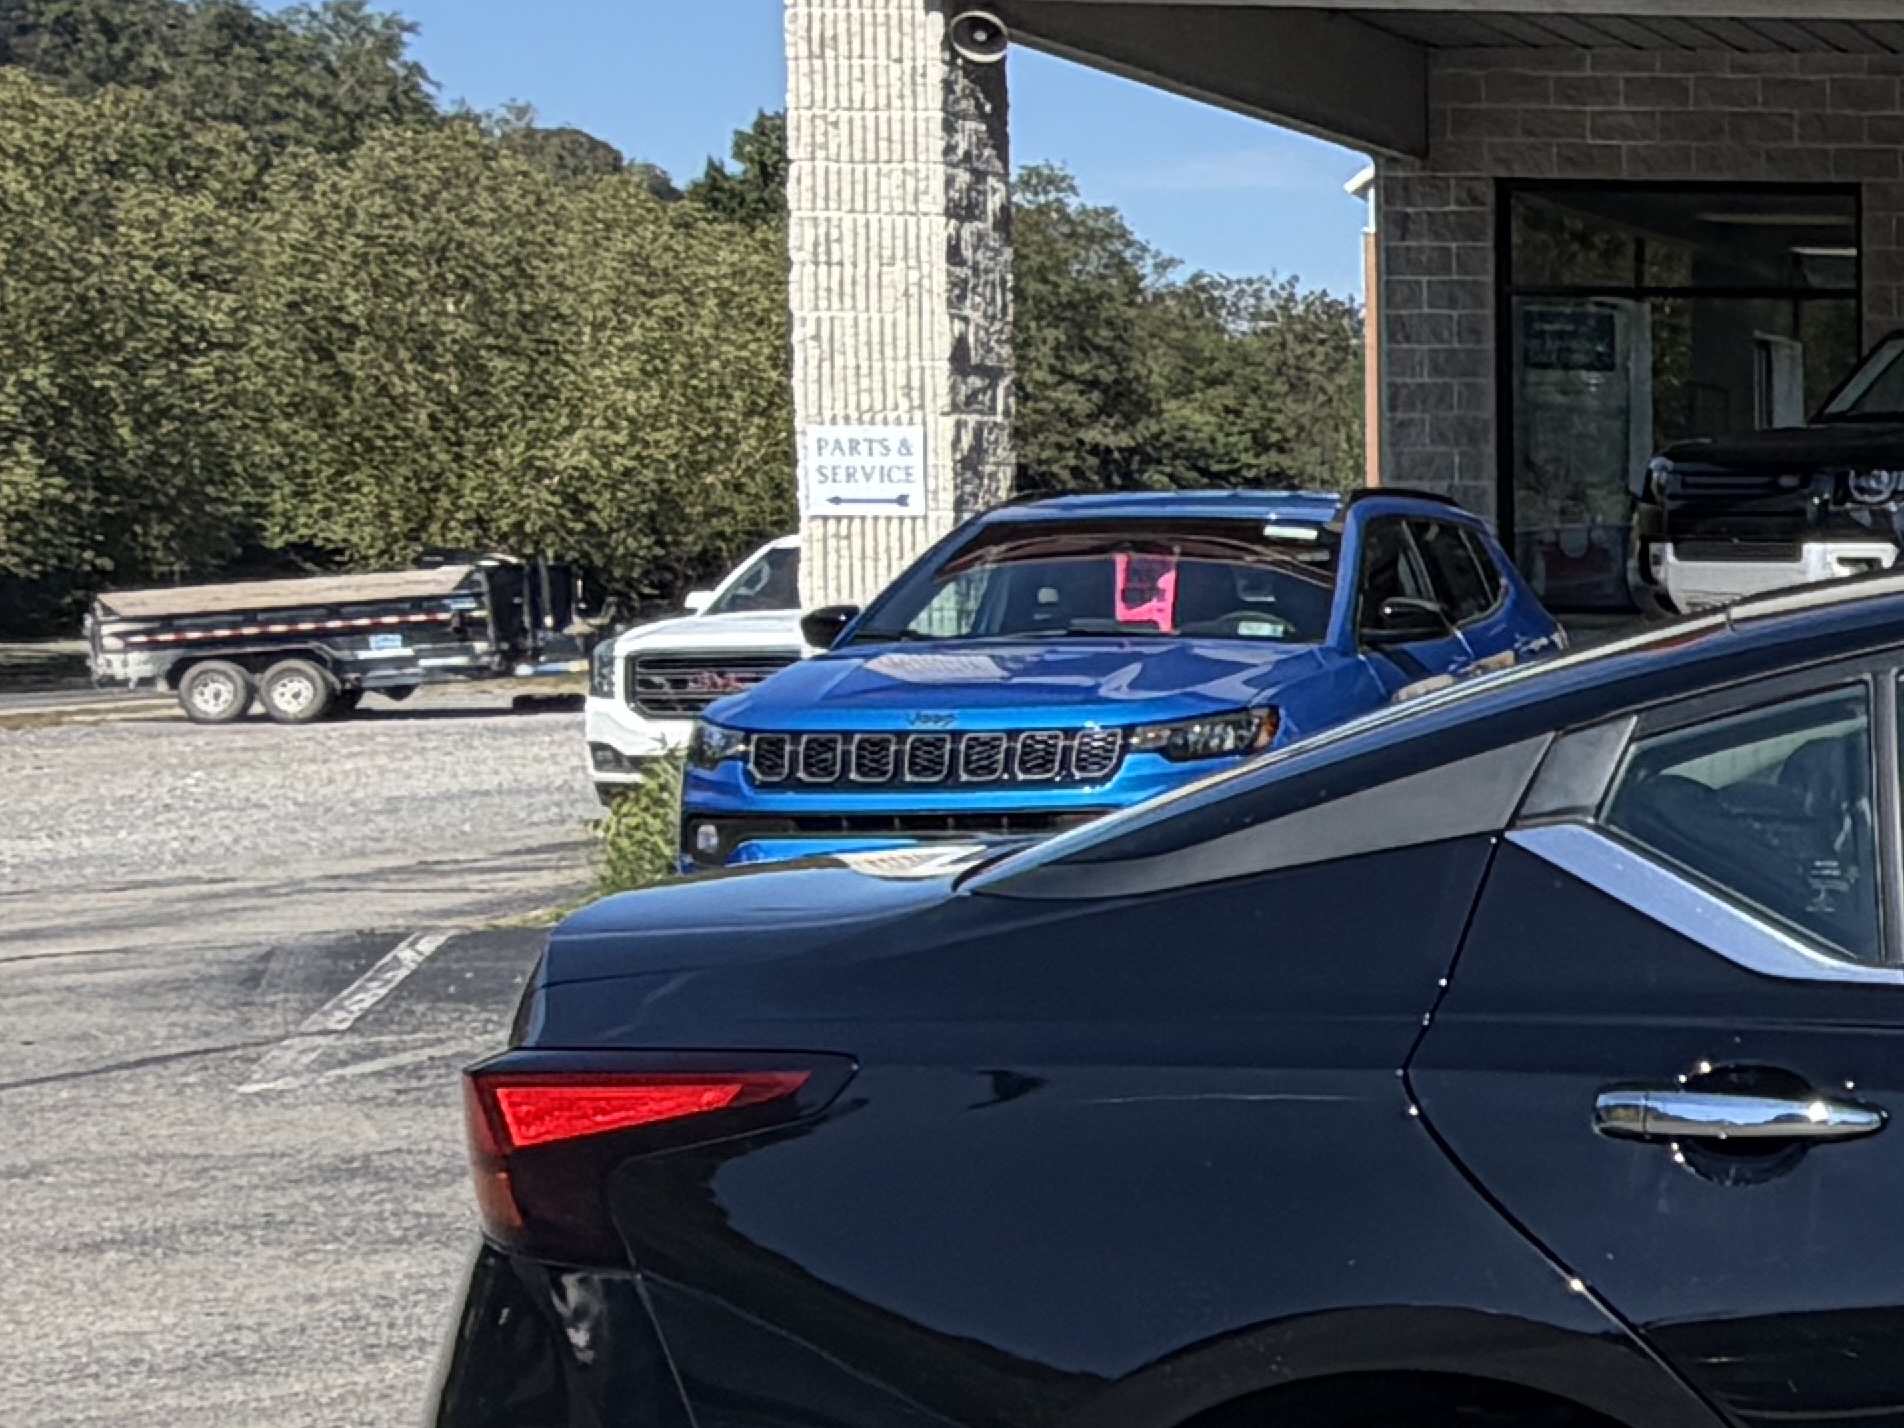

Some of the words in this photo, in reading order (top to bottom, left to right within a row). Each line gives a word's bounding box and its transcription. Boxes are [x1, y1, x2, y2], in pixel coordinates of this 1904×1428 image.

[816, 437, 892, 458] PARTS
[897, 436, 914, 457] &
[816, 465, 916, 484] SERVICE
